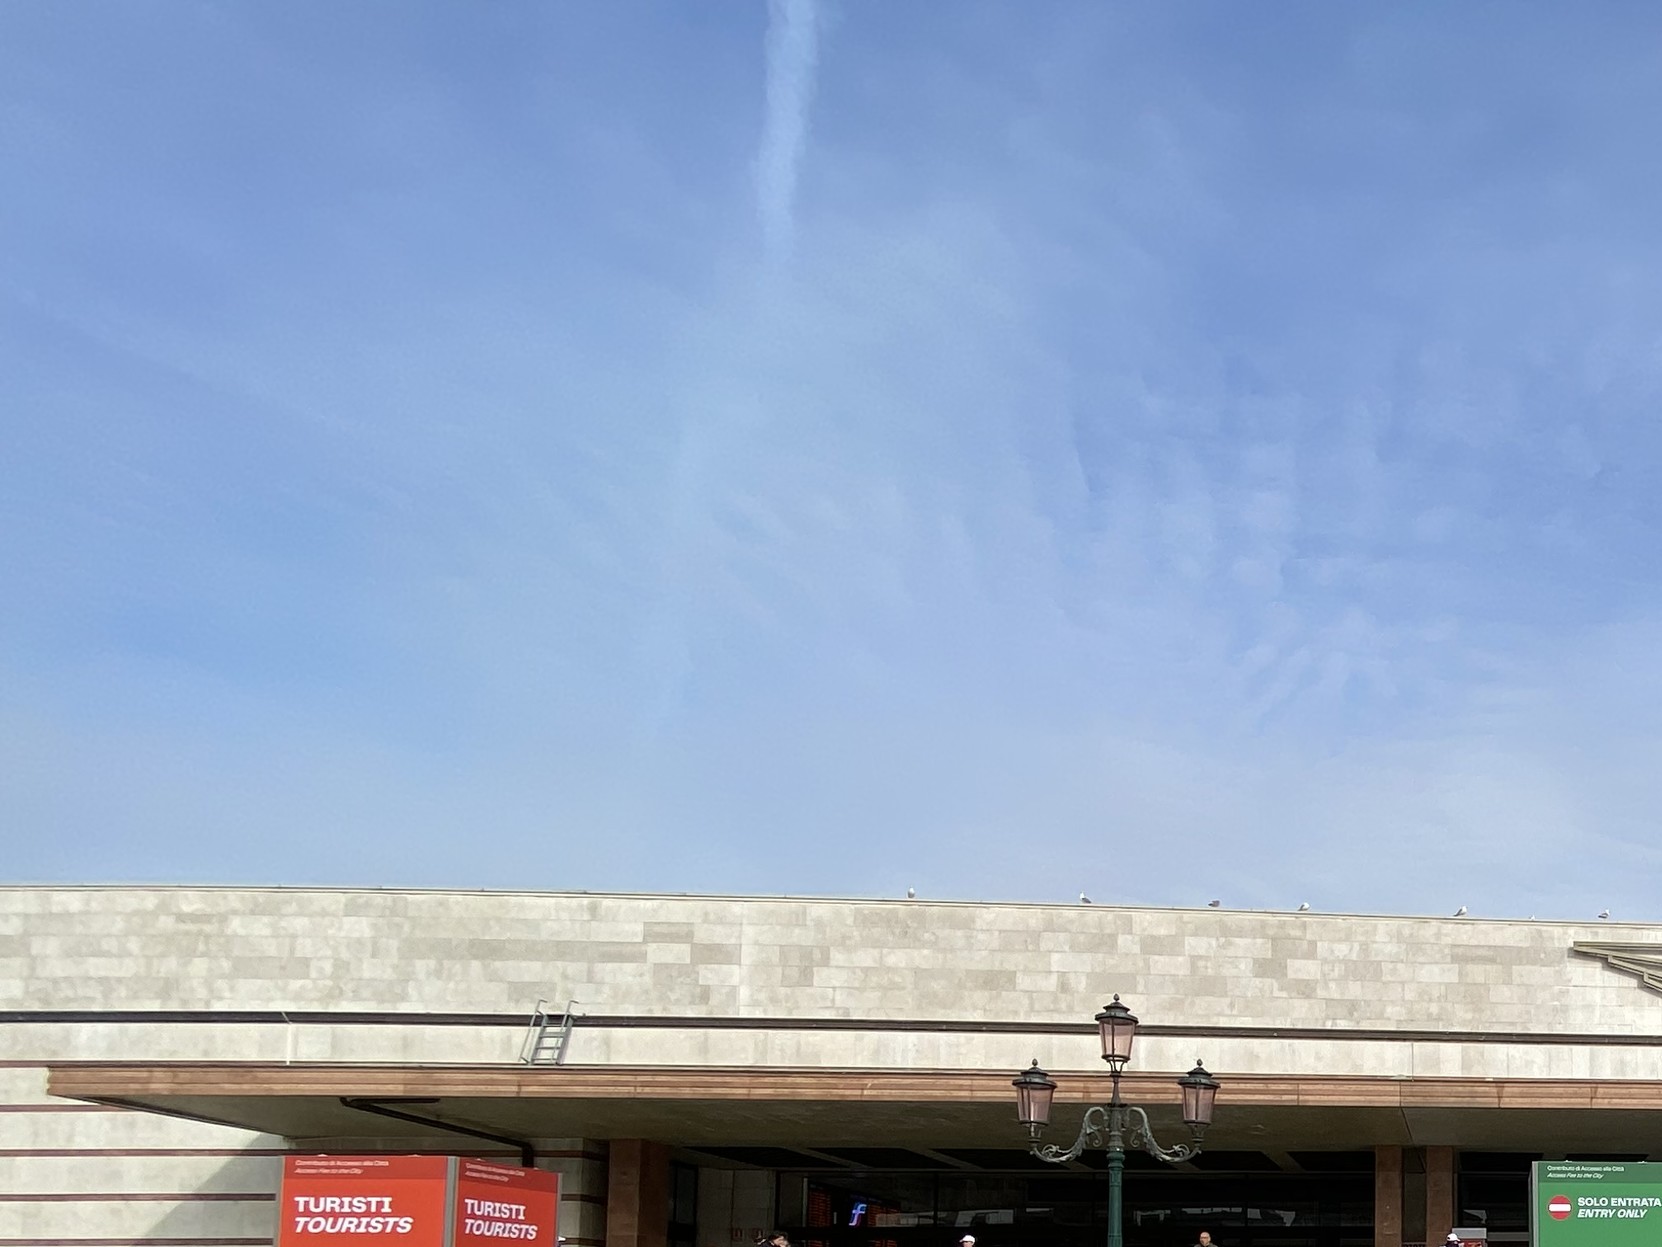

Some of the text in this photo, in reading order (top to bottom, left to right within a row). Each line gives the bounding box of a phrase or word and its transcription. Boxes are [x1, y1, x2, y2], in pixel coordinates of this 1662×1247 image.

[294, 1196, 393, 1213] TURISTI
[464, 1198, 526, 1220] TURISTI
[1577, 1197, 1662, 1207] SOLO ENTRATA
[1577, 1208, 1648, 1218] ENTRY ONLY
[295, 1216, 414, 1234] TOURISTS
[465, 1219, 538, 1240] TOURISTS
